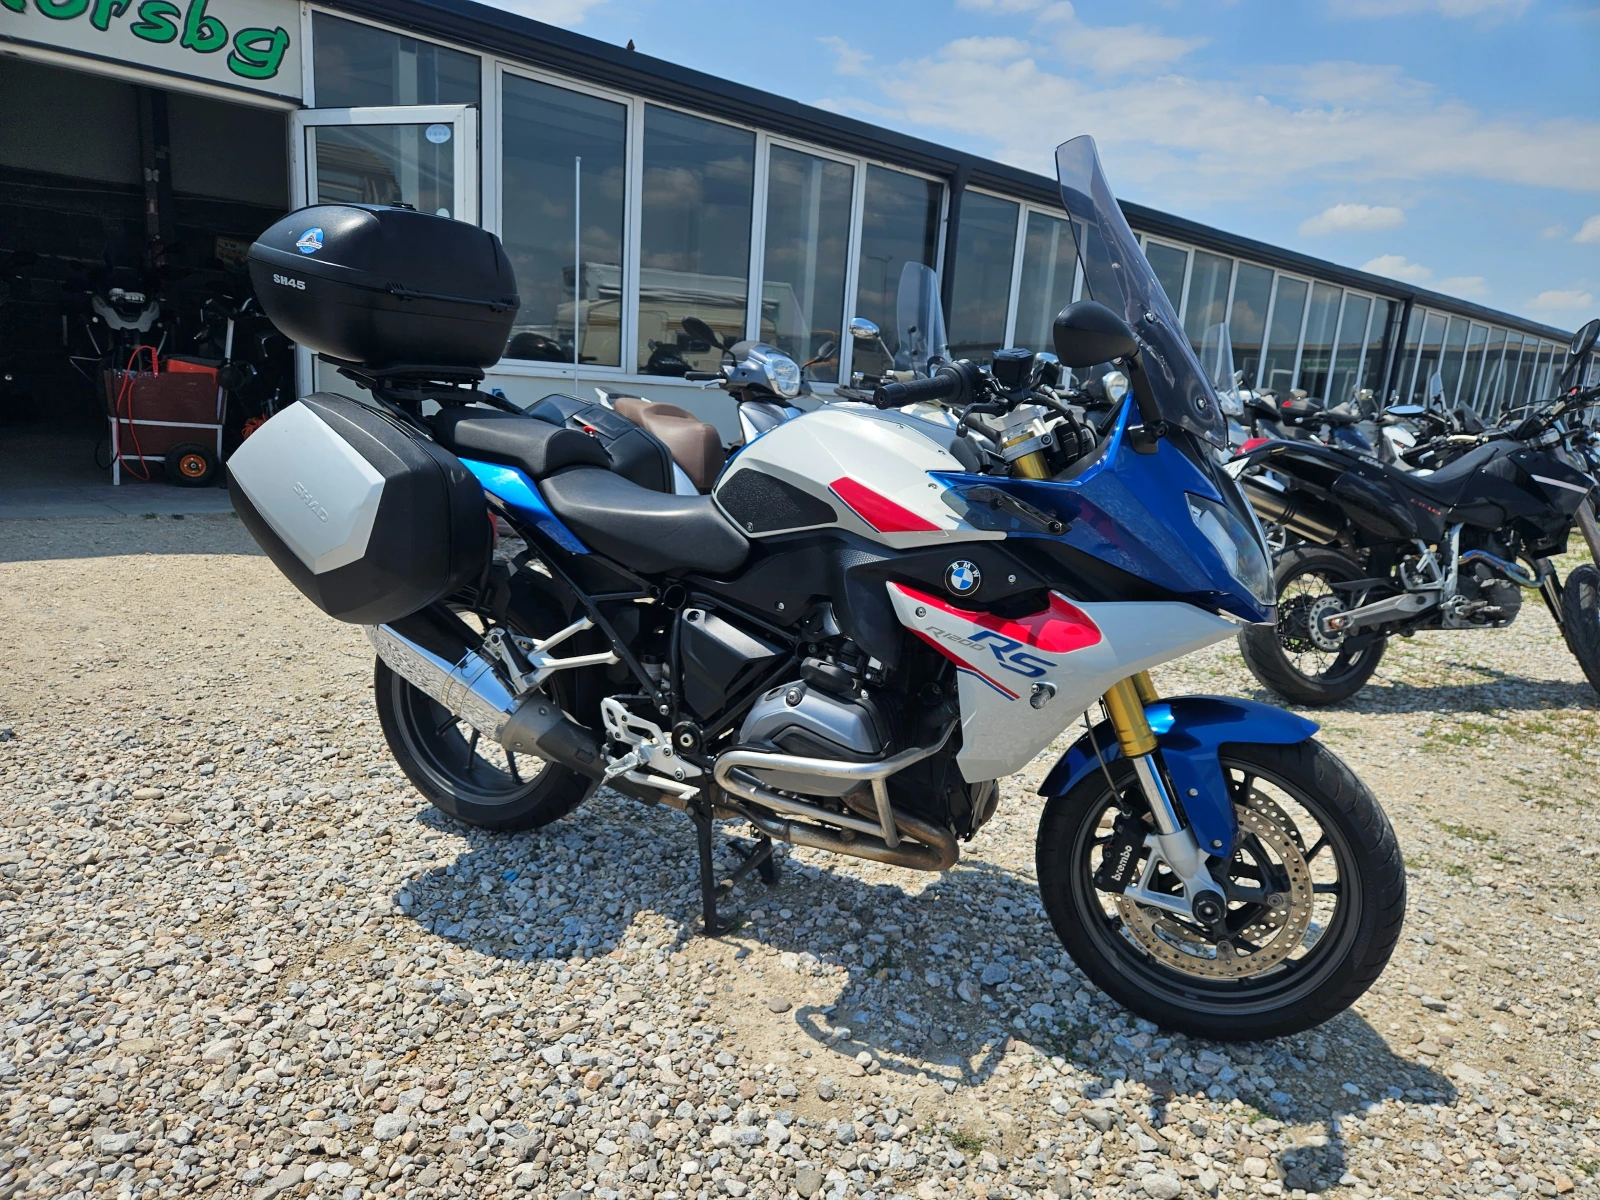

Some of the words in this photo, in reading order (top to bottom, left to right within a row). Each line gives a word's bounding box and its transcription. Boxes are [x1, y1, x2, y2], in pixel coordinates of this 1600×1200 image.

[273, 273, 306, 290] SH45
[951, 561, 981, 578] BMW
[925, 625, 987, 651] R1200
[967, 630, 1058, 678] RS
[1111, 845, 1133, 881] brembo
